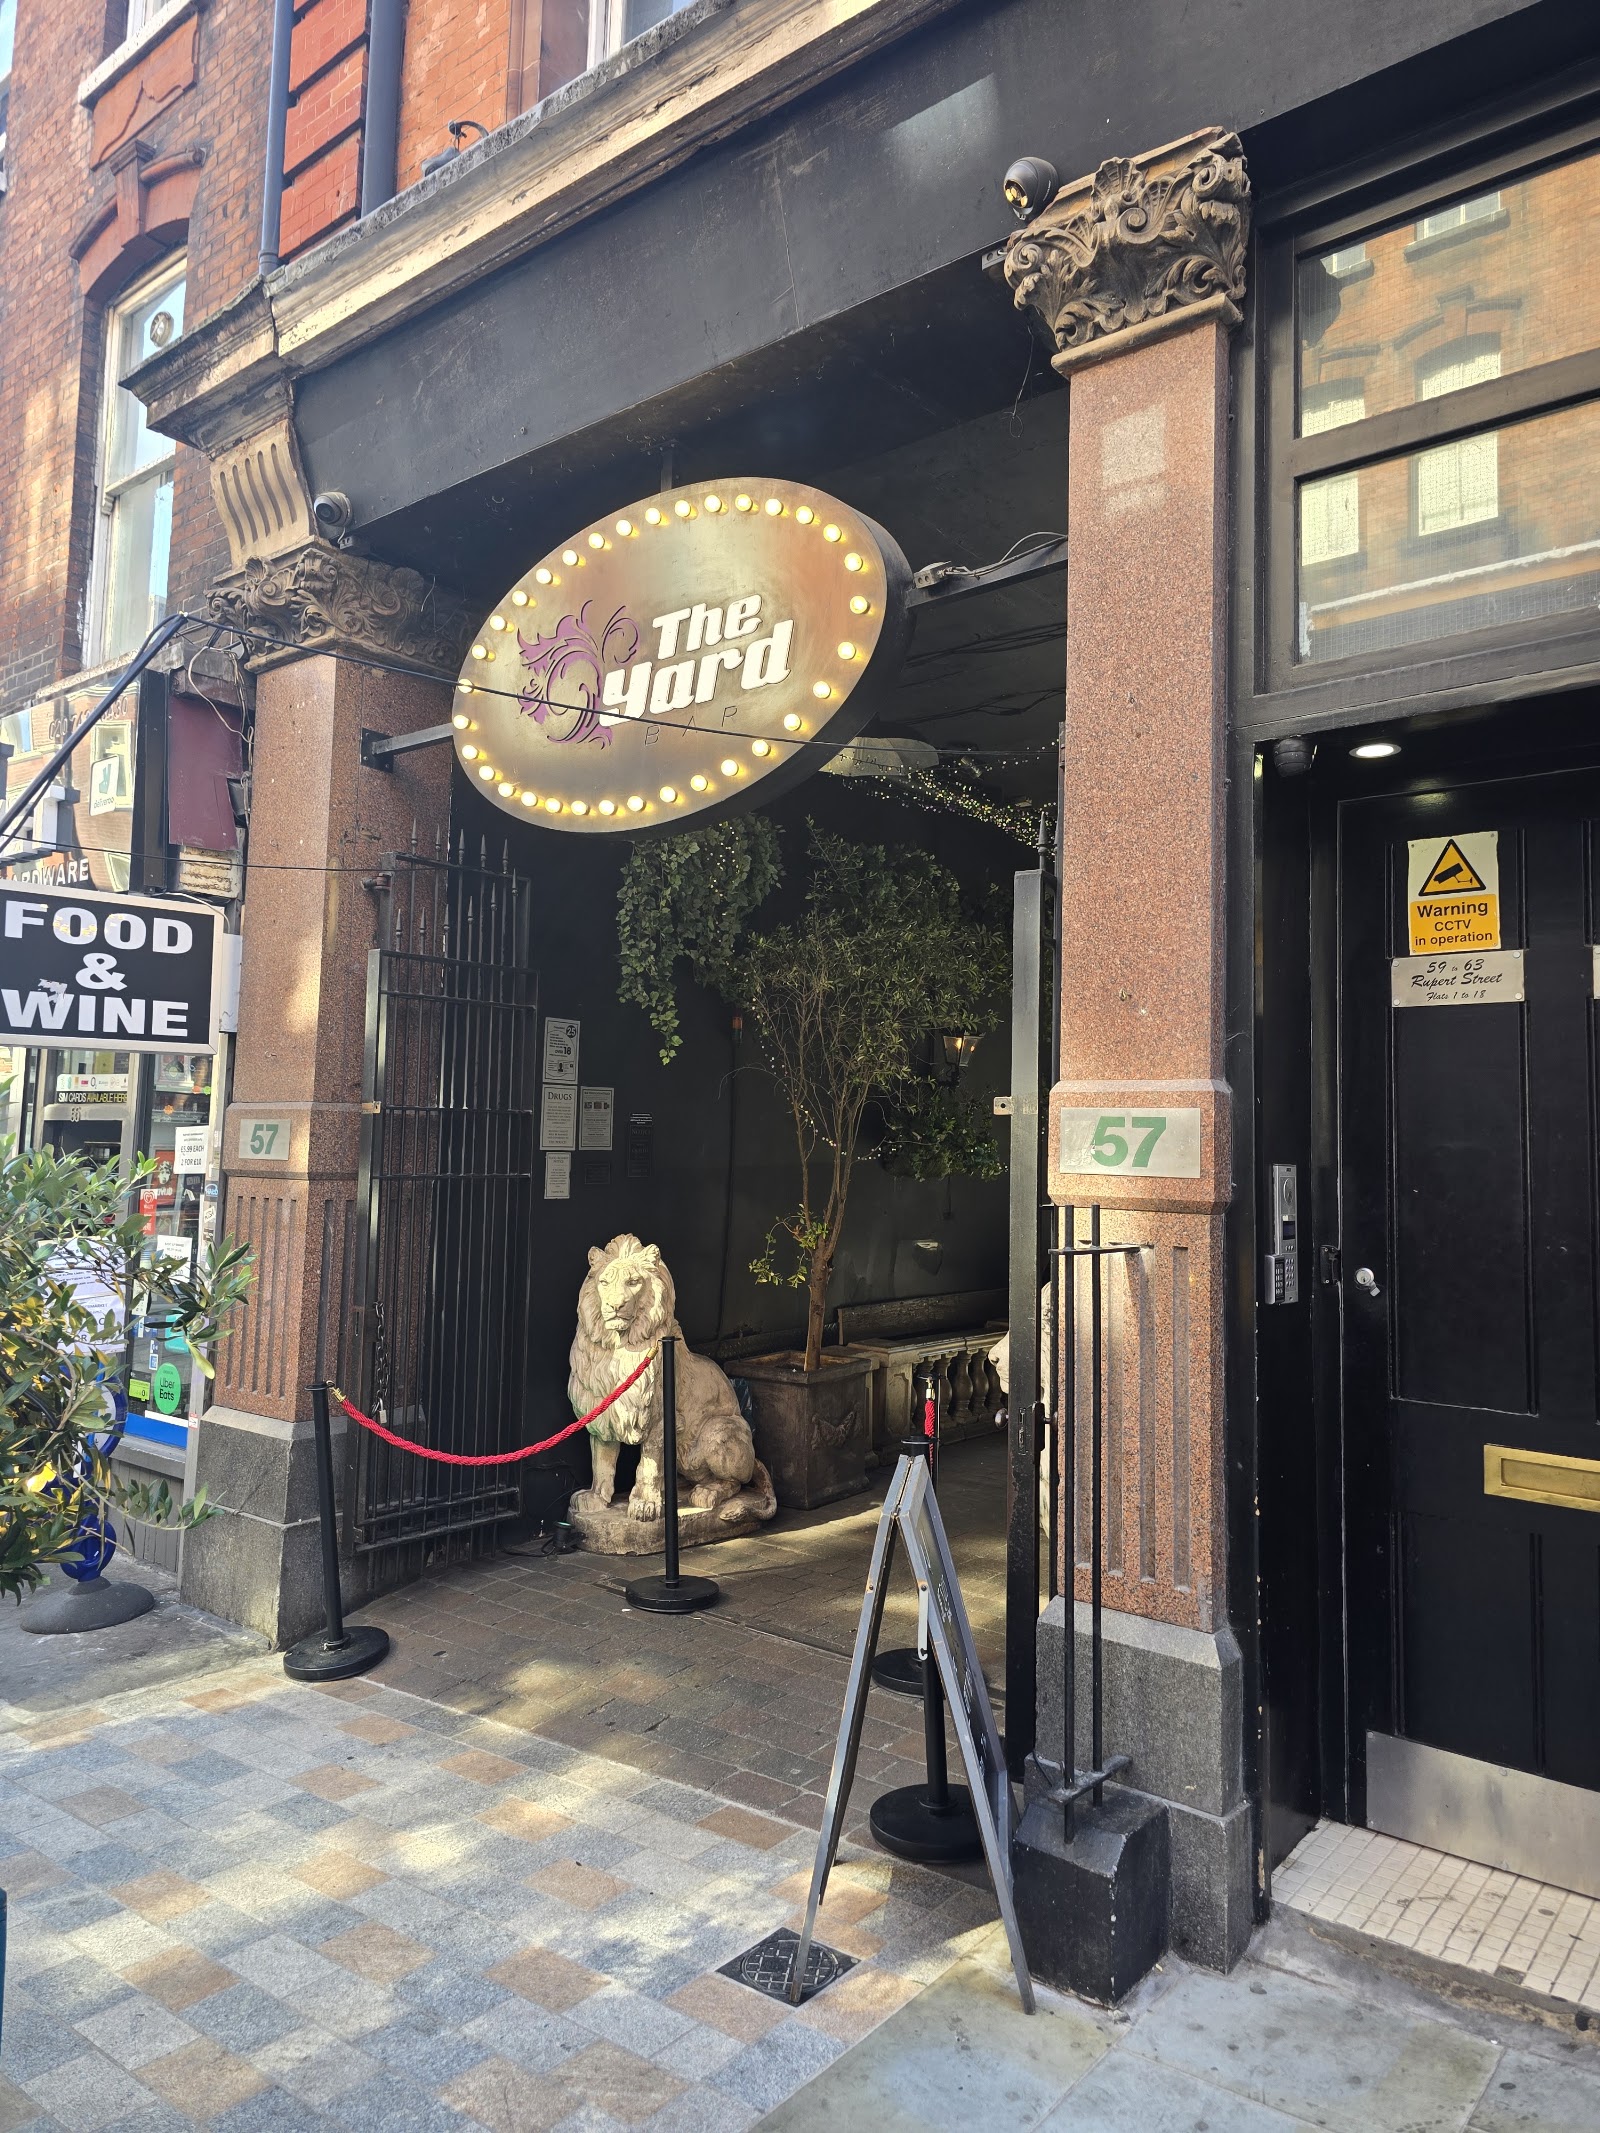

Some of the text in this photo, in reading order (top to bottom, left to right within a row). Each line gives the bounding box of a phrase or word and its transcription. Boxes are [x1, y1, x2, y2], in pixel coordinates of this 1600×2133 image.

[652, 594, 763, 660] The
[644, 705, 739, 747] BAR
[1417, 901, 1489, 917] Warning
[5, 900, 194, 954] FOOD
[1434, 919, 1472, 932] CCTV
[1415, 931, 1493, 946] in operation
[75, 953, 127, 991] &
[1427, 961, 1447, 974] 59
[1464, 958, 1485, 971] 63
[1411, 972, 1503, 991] Rupert Street
[1461, 991, 1469, 999] to
[1473, 989, 1486, 999] 18
[1, 989, 189, 1037] WINE
[567, 1027, 576, 1036] 25
[563, 1046, 571, 1055] 18
[58, 1093, 69, 1102] SIM
[69, 1093, 86, 1102] CARDS
[87, 1093, 113, 1103] AVAILABLE
[250, 1123, 278, 1155] 57
[1091, 1116, 1167, 1168] 57
[185, 1158, 193, 1166] FOR
[159, 1377, 175, 1389] Uber
[159, 1388, 175, 1401] Eats
